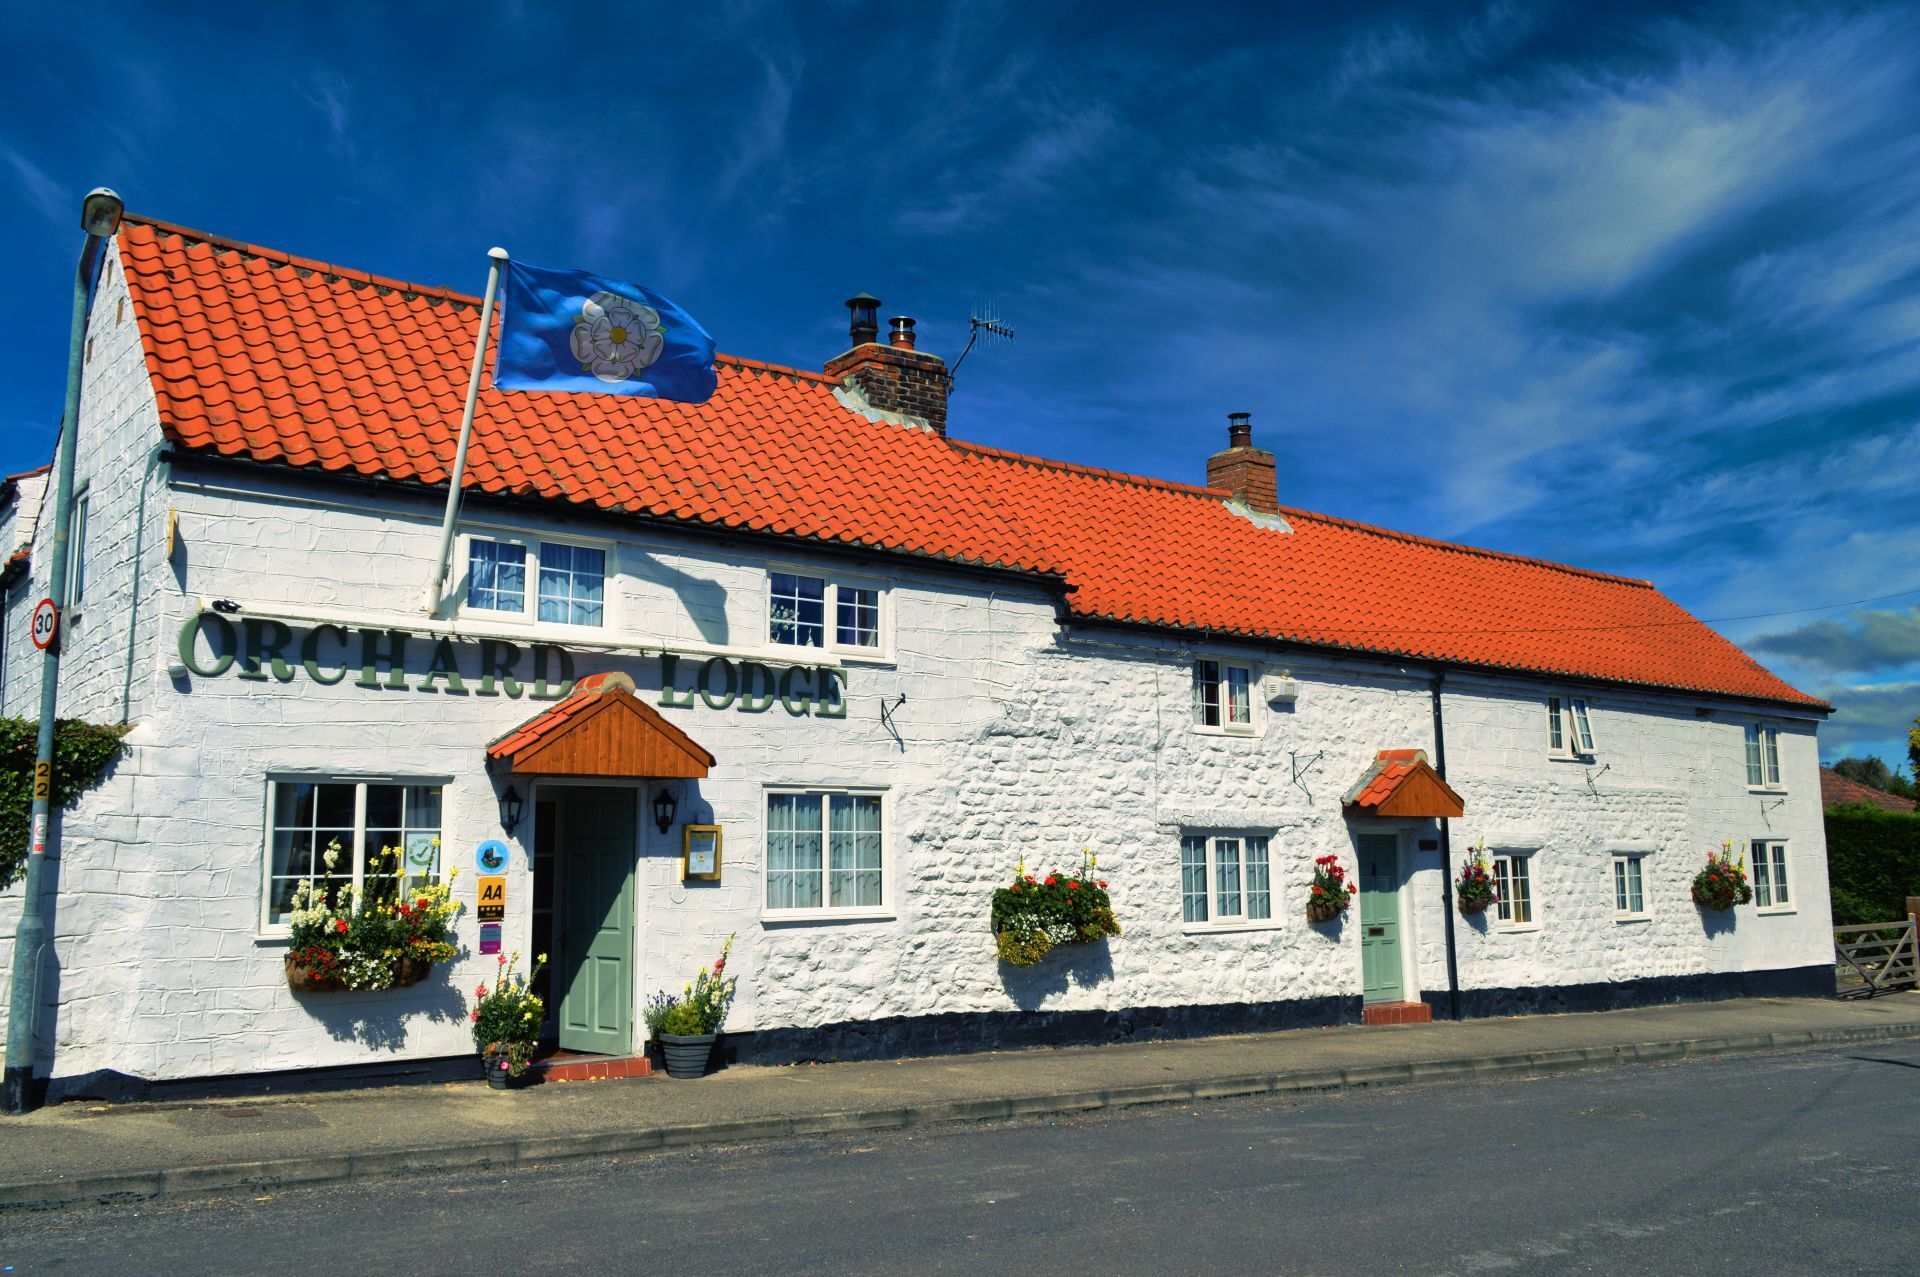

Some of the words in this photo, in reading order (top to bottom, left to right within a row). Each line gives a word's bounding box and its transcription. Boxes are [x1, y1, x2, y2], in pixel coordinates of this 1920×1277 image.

[35, 613, 53, 635] 30
[178, 612, 575, 700] ORCHARD
[657, 654, 848, 719] LODGE
[482, 885, 502, 901] AA
